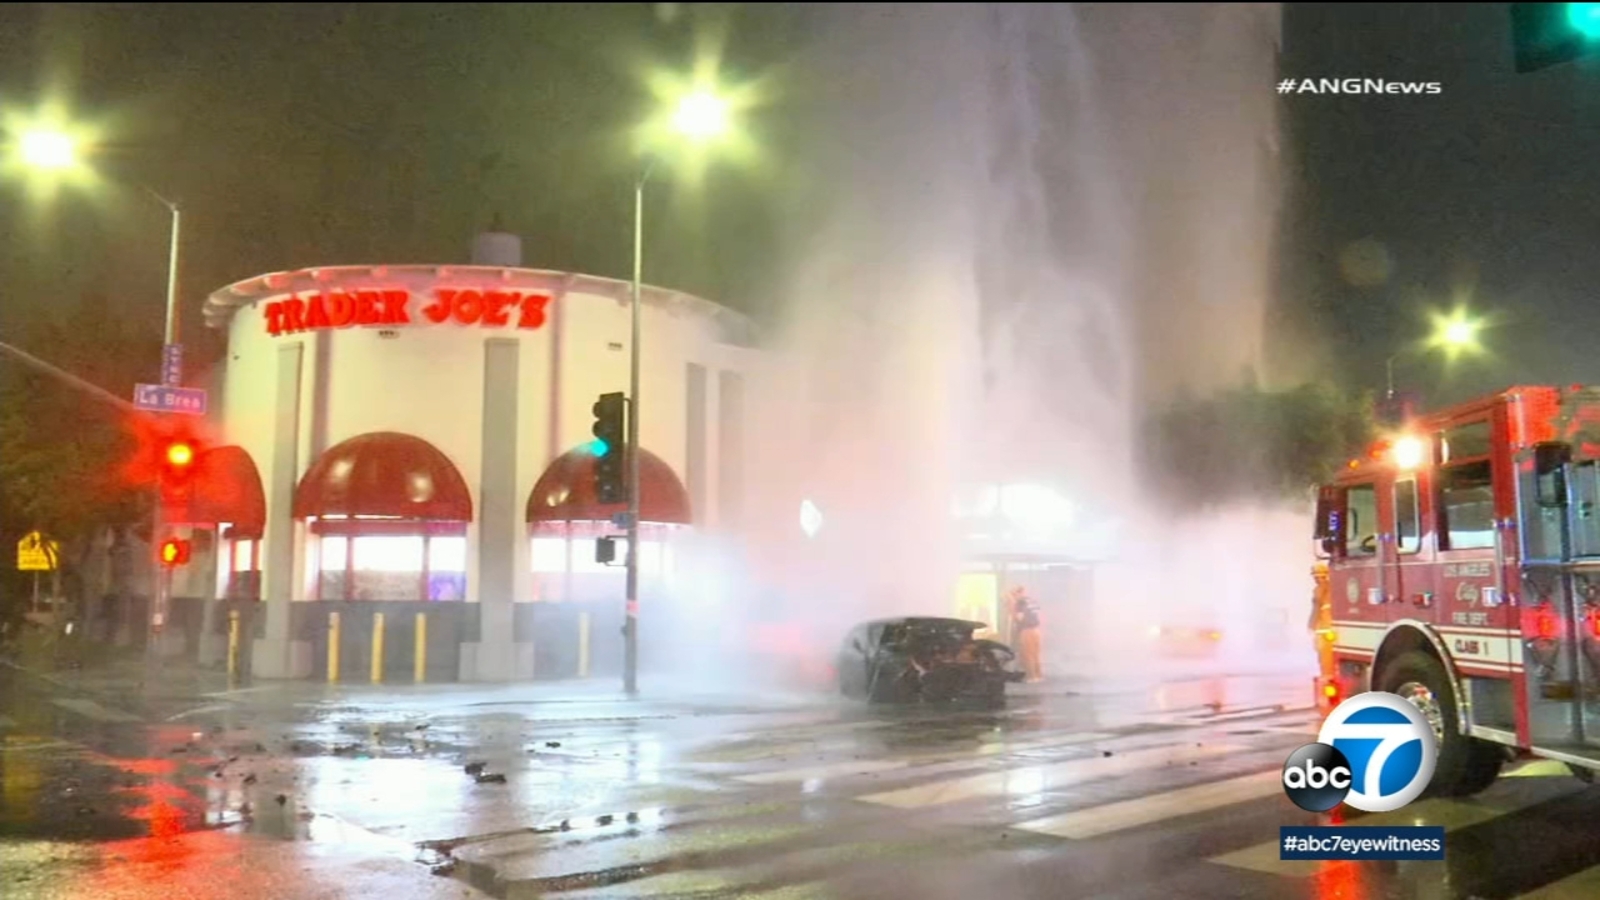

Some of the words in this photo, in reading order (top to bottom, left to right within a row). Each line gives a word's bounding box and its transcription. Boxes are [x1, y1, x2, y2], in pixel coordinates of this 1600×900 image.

[264, 289, 410, 337] TRADER
[421, 289, 550, 329] JOE'S
[140, 390, 158, 405] La
[165, 393, 201, 409] Brea
